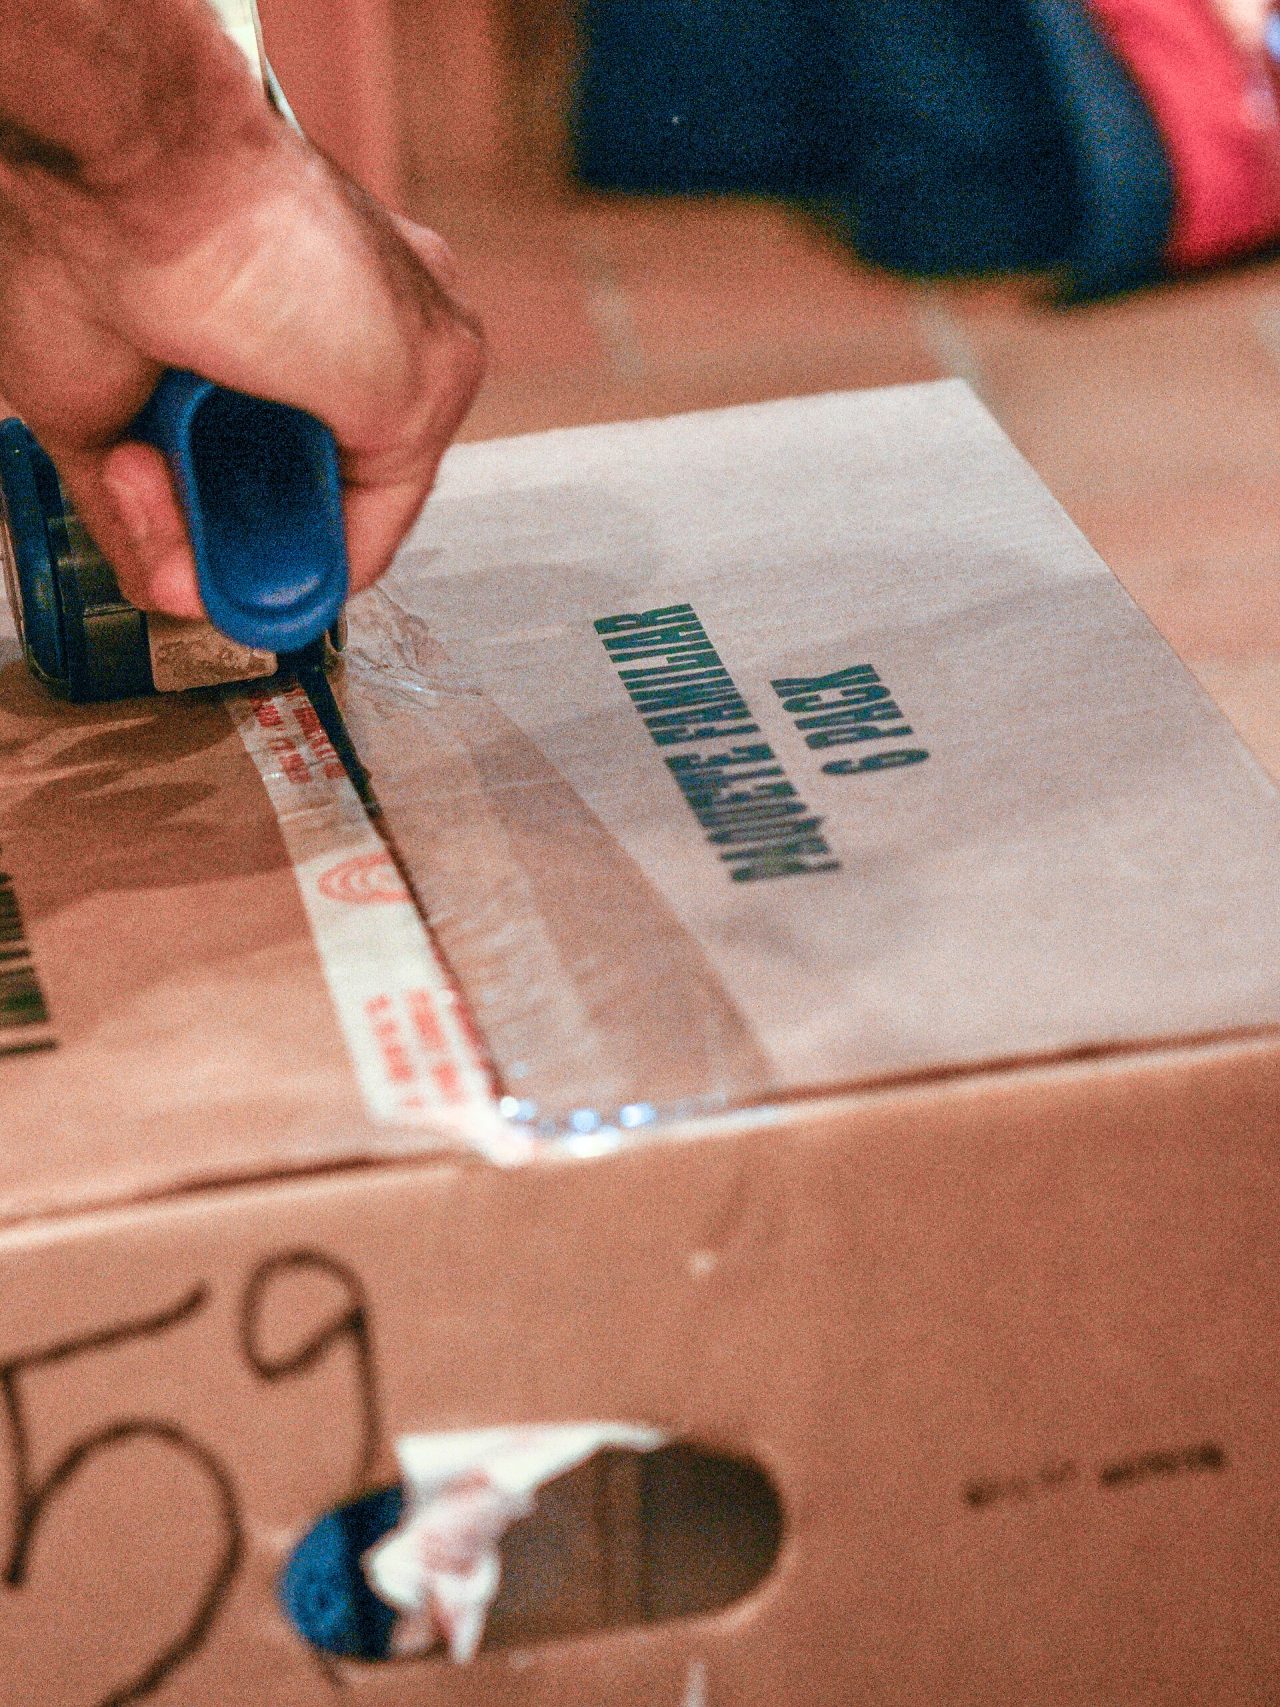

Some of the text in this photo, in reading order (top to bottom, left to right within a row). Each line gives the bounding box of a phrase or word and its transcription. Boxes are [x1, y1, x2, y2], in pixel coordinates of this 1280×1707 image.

[593, 602, 842, 884] PAQUETE FAMILIAR
[770, 663, 930, 776] 6 PACK
